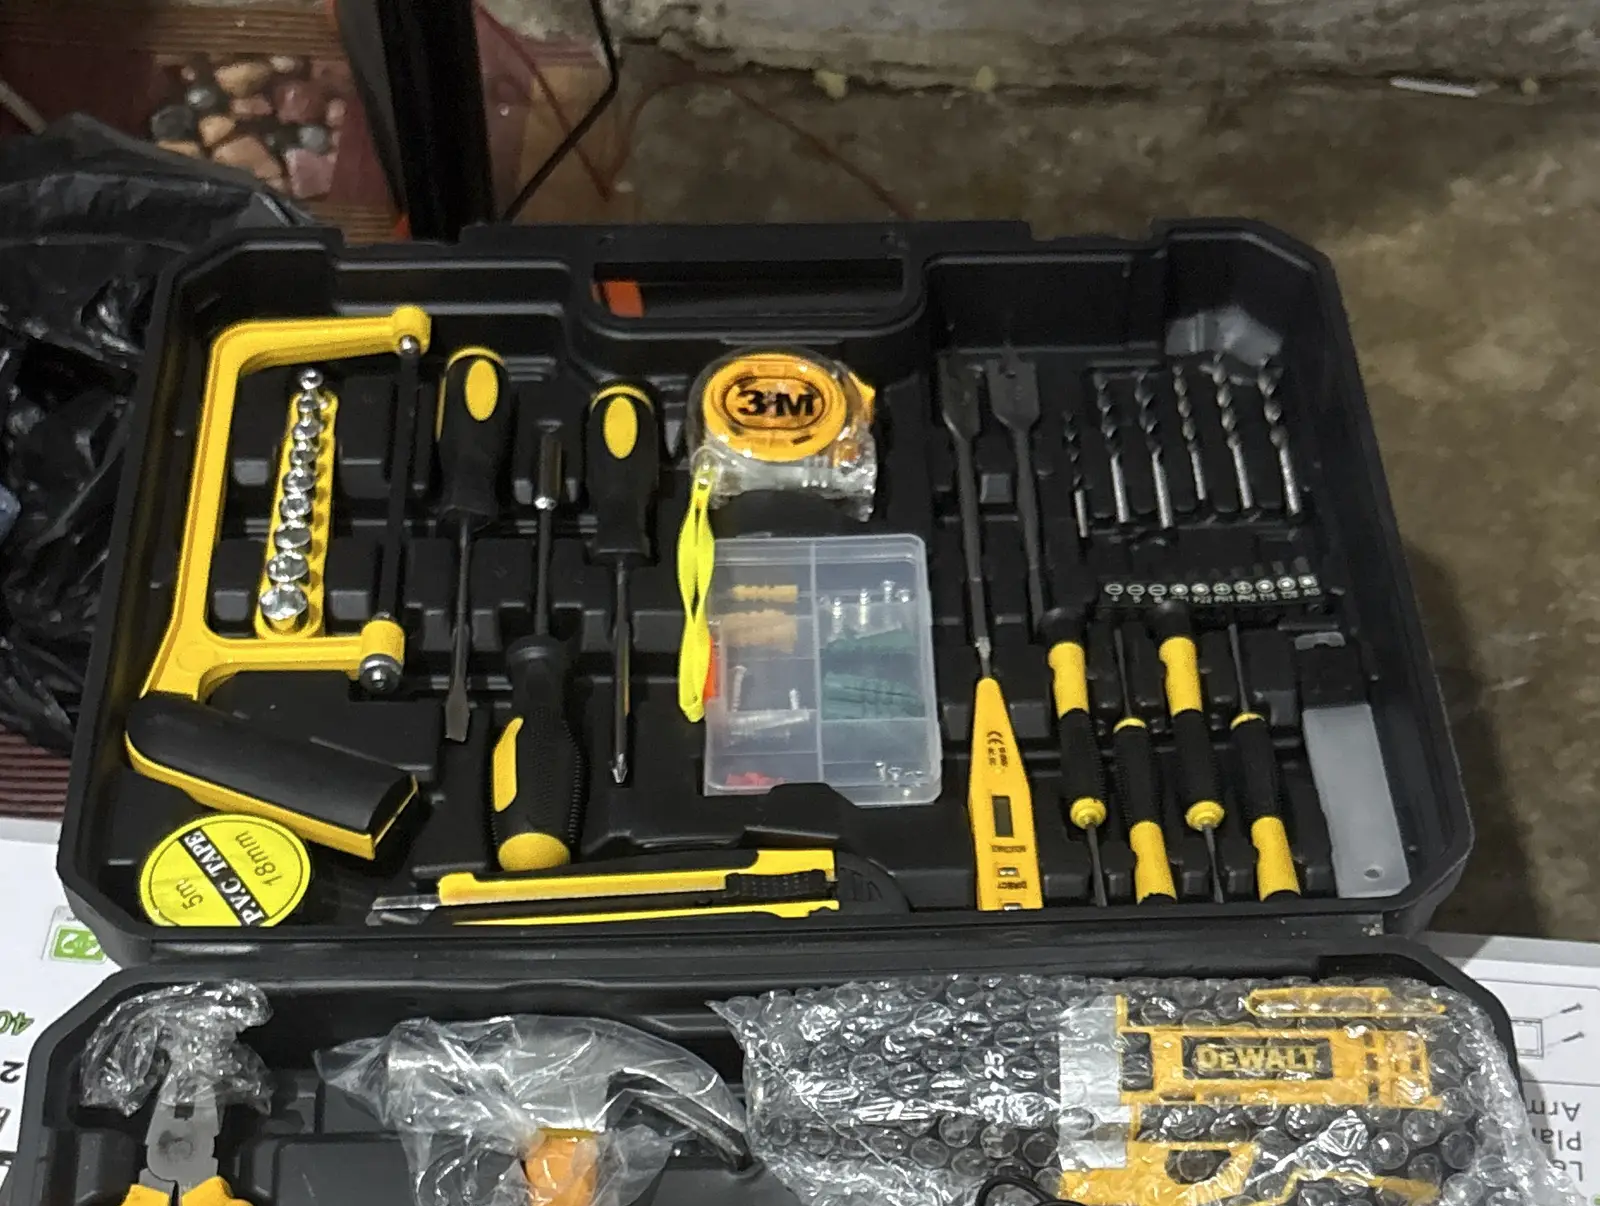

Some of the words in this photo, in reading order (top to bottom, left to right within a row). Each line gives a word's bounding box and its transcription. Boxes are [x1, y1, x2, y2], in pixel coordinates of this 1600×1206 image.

[184, 830, 228, 878] TAPE
[235, 830, 283, 887] 18mm
[176, 878, 204, 910] 5m
[220, 878, 265, 925] P.V.C
